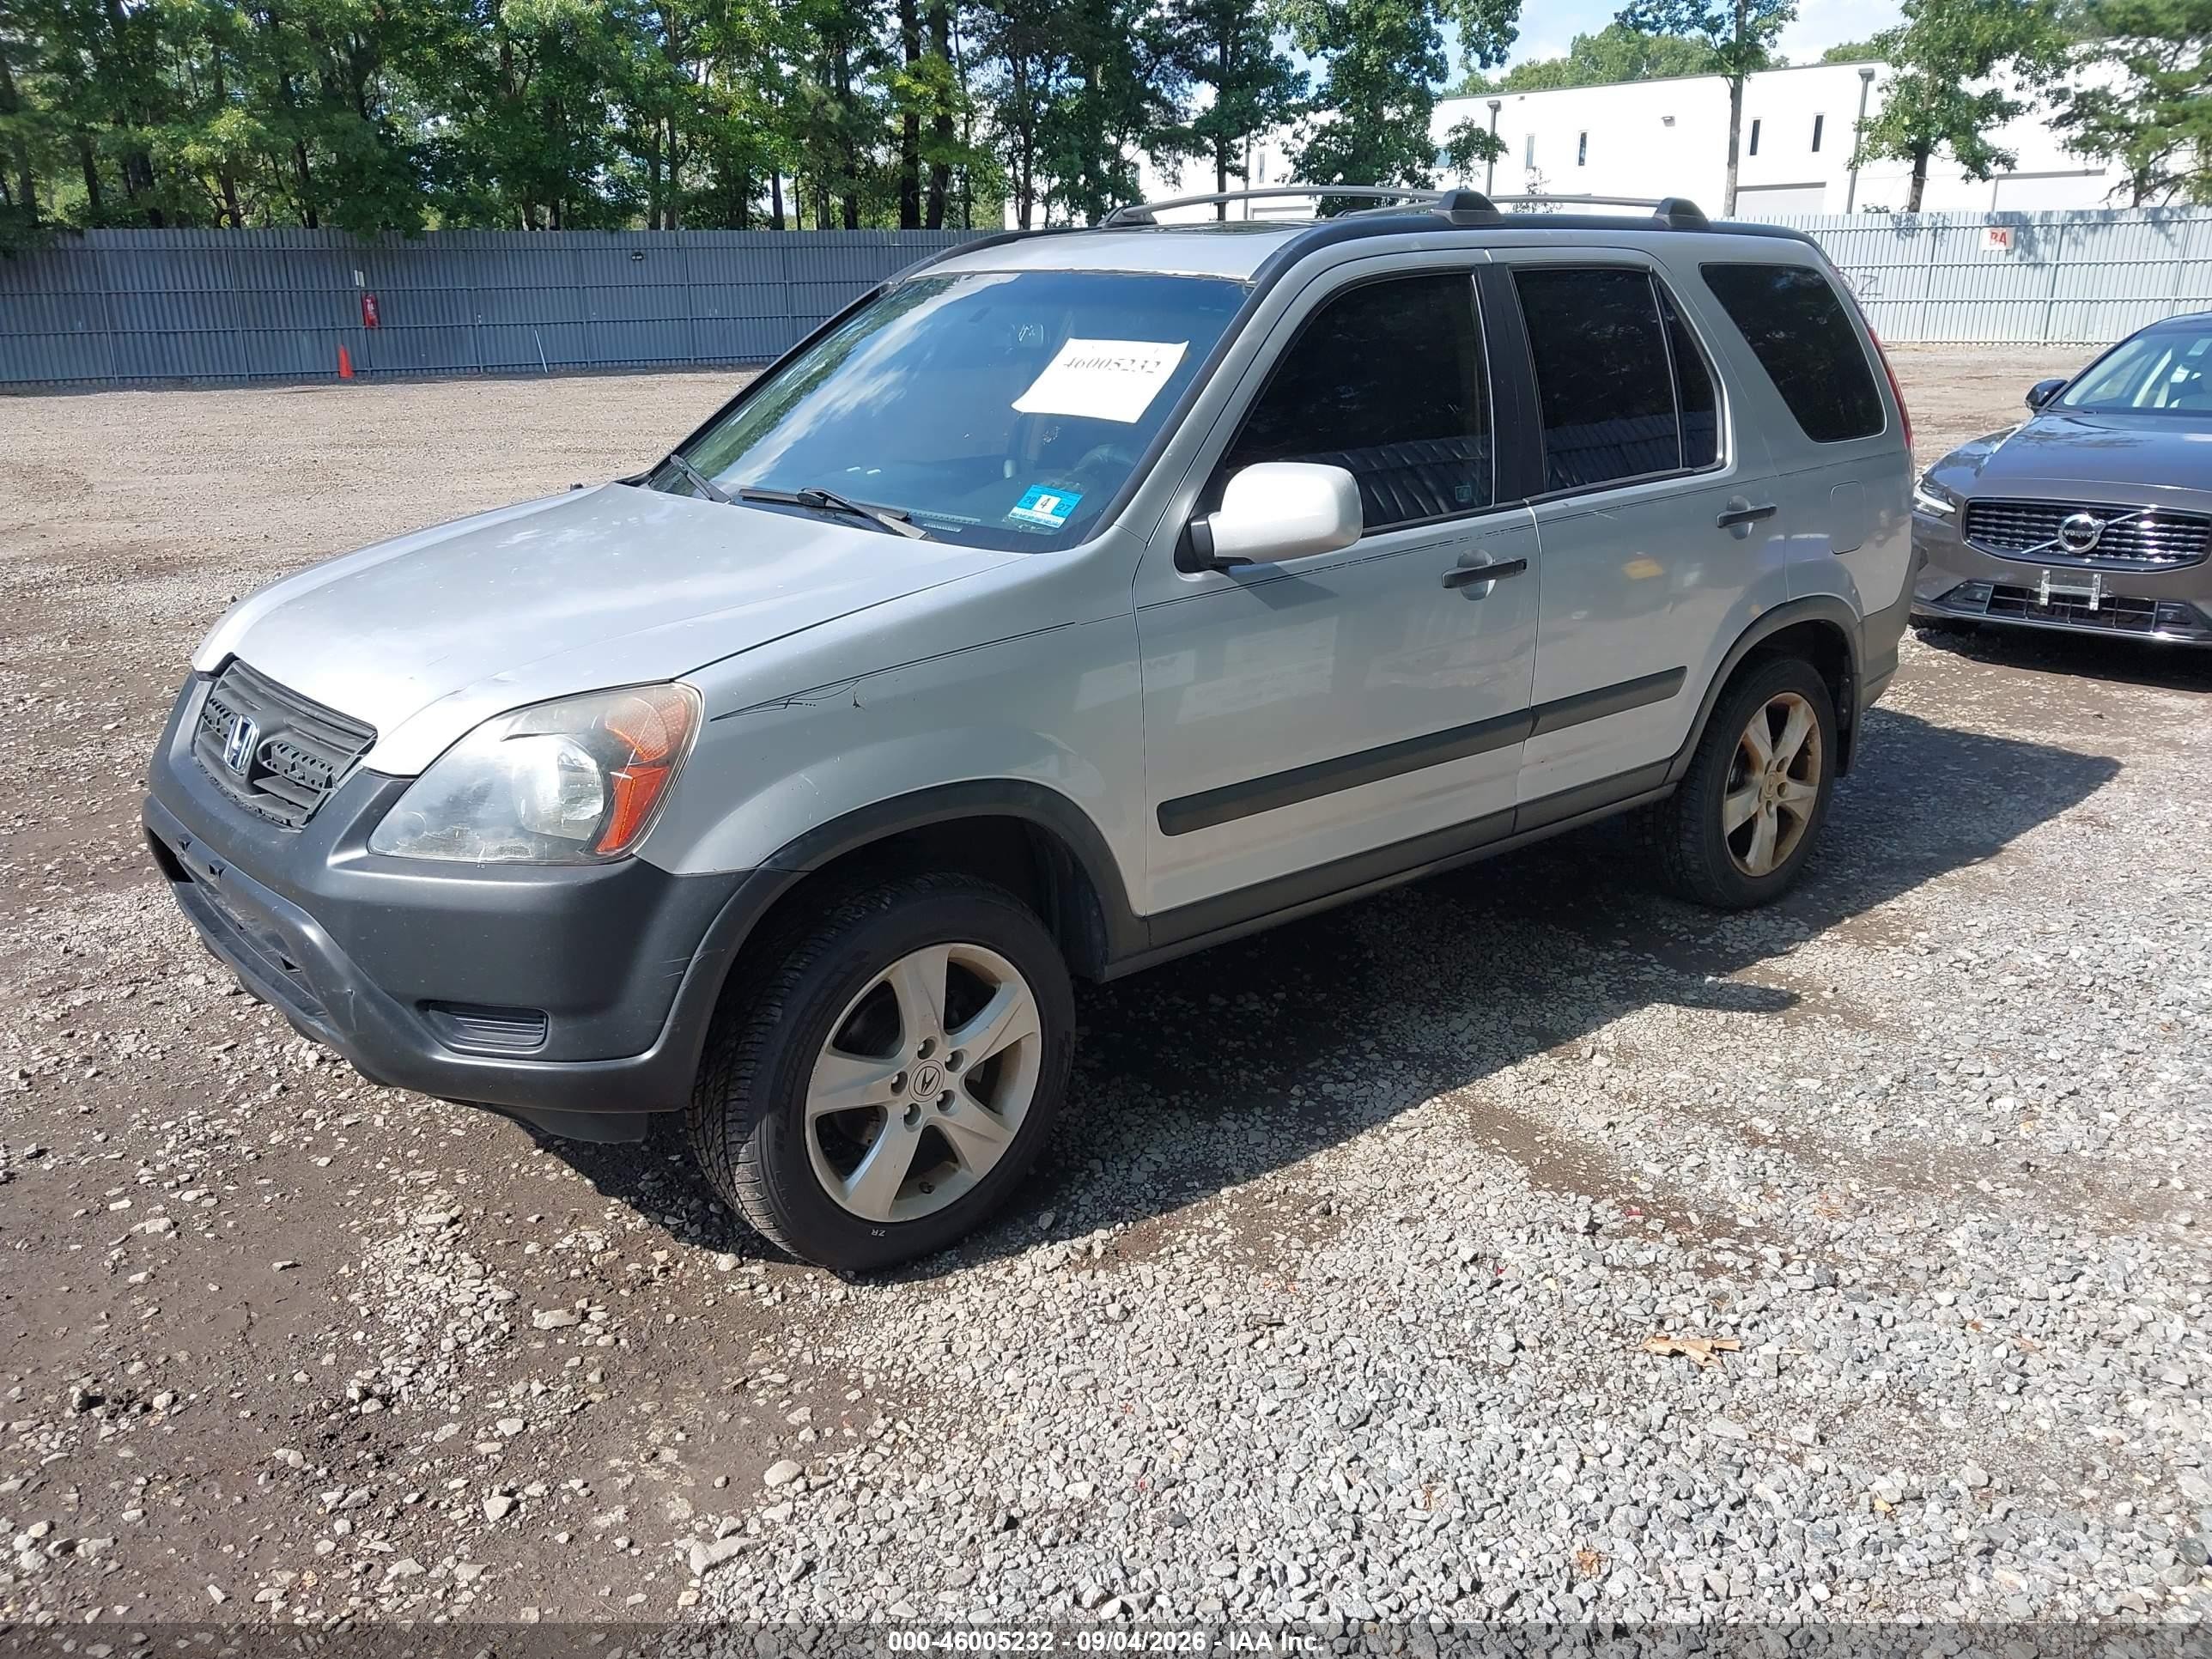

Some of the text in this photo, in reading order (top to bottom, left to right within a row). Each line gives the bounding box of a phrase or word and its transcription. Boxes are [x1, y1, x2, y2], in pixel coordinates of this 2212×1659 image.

[1063, 356, 1161, 374] 46005232
[1041, 497, 1051, 509] 4
[1055, 502, 1073, 512] 27
[2063, 529, 2092, 538] VOO
[871, 1228, 886, 1237] ZR
